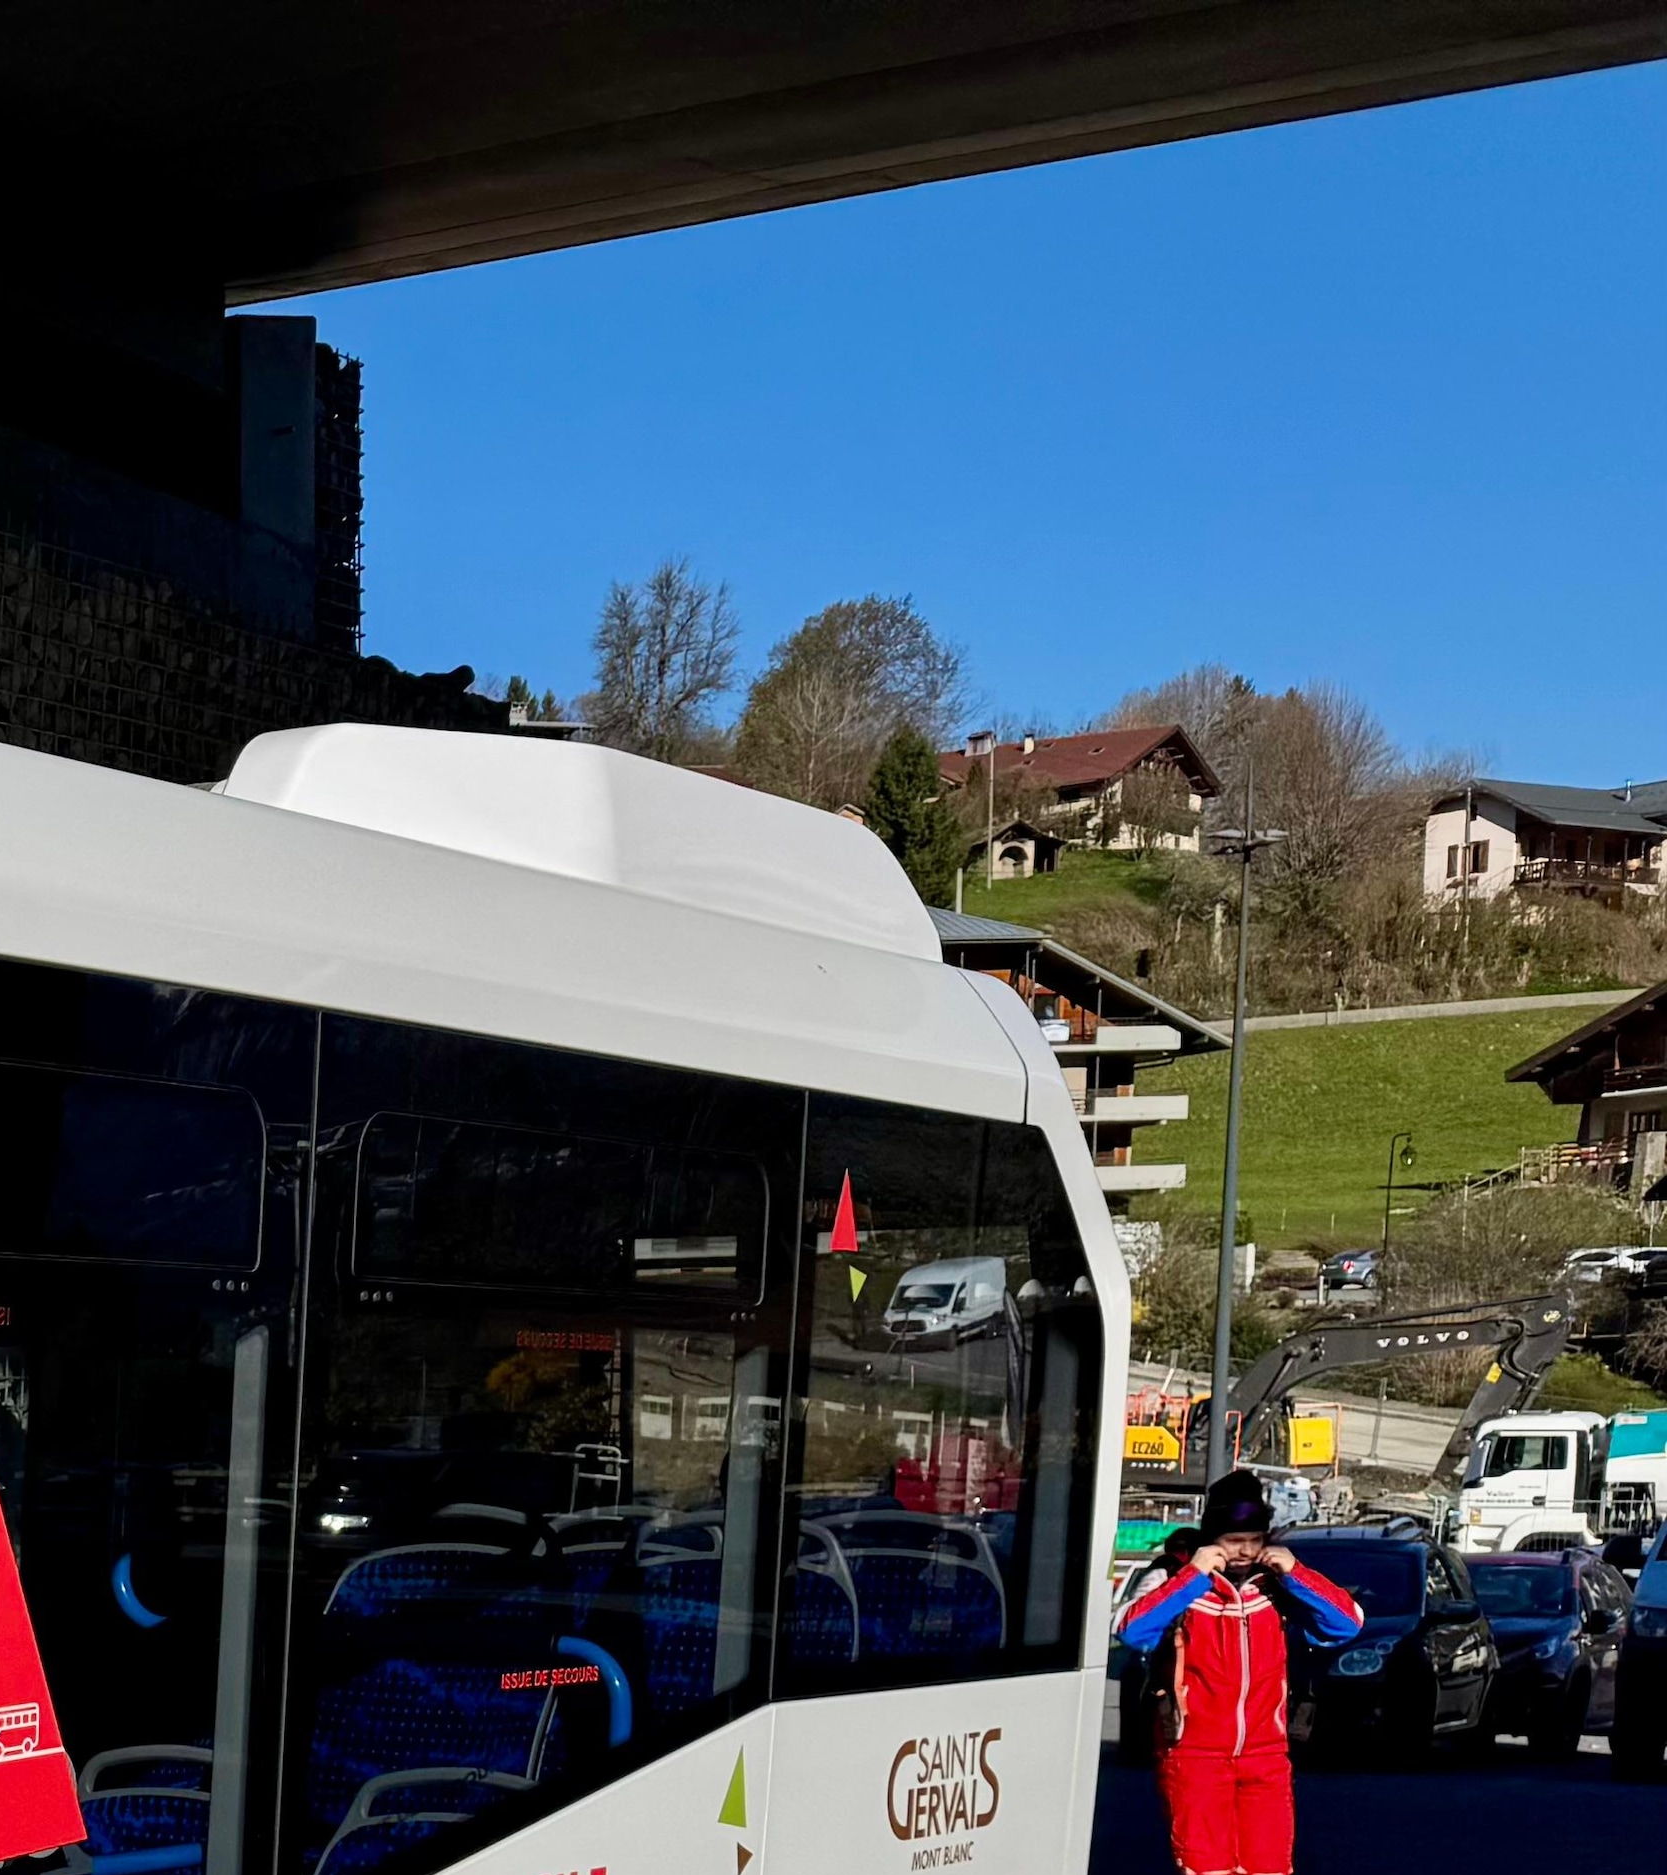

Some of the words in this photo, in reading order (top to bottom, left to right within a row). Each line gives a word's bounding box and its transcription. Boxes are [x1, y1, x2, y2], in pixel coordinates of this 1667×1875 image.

[1376, 1330, 1469, 1348] VOLVO
[501, 1670, 533, 1690] ISSUE
[534, 1670, 549, 1687] DE
[551, 1665, 599, 1685] SECOURS
[917, 1732, 981, 1784] SAINT
[887, 1727, 1003, 1841] GERVAIS
[911, 1847, 942, 1872] MONT
[943, 1841, 975, 1866] BLANC
